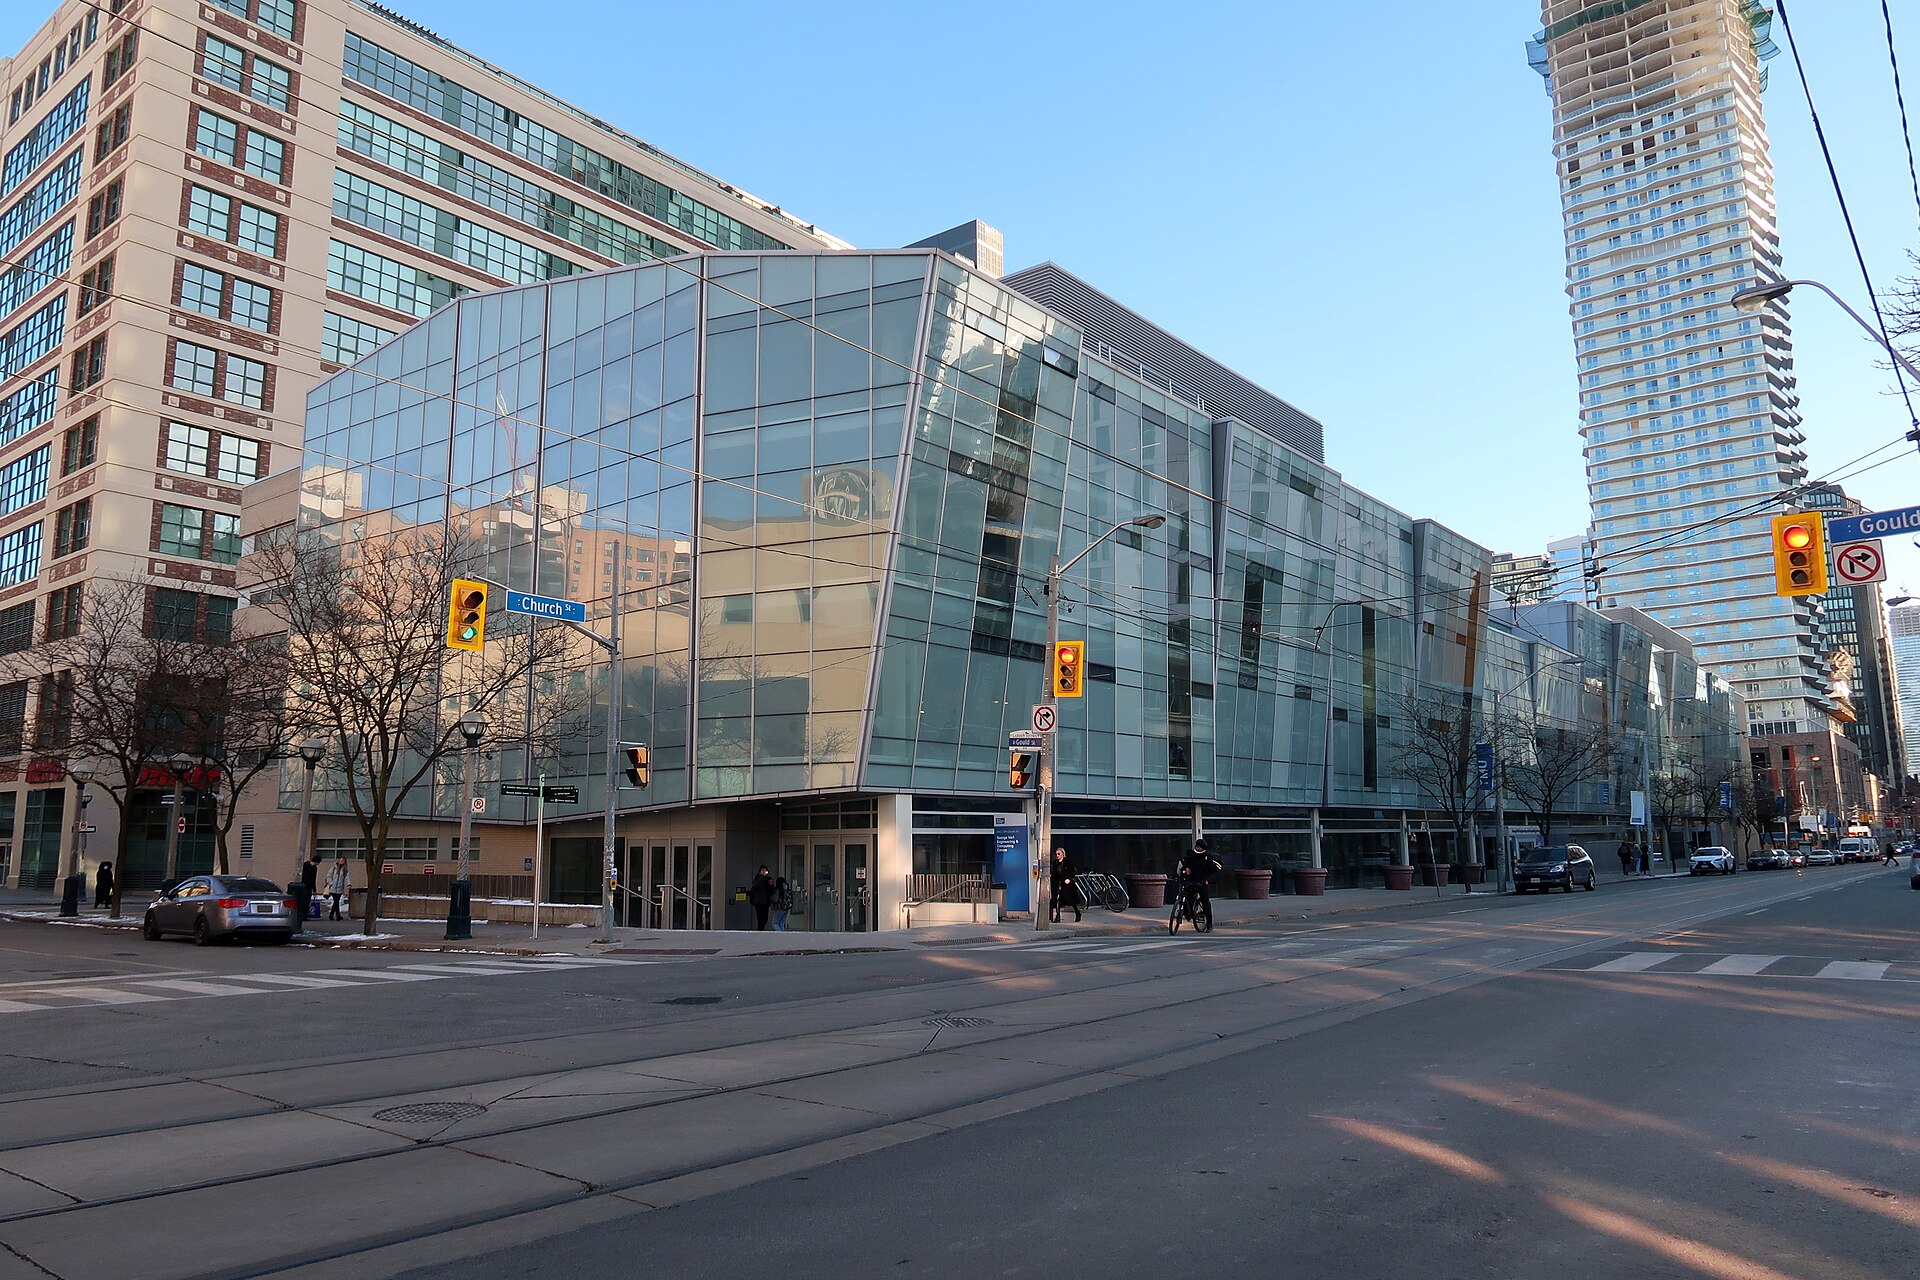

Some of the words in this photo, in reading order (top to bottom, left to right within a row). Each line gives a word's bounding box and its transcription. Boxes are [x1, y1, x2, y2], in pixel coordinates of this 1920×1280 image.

[1859, 509, 1920, 534] Gould
[522, 596, 562, 616] Church
[565, 603, 572, 612] St
[1016, 738, 1030, 746] Gould
